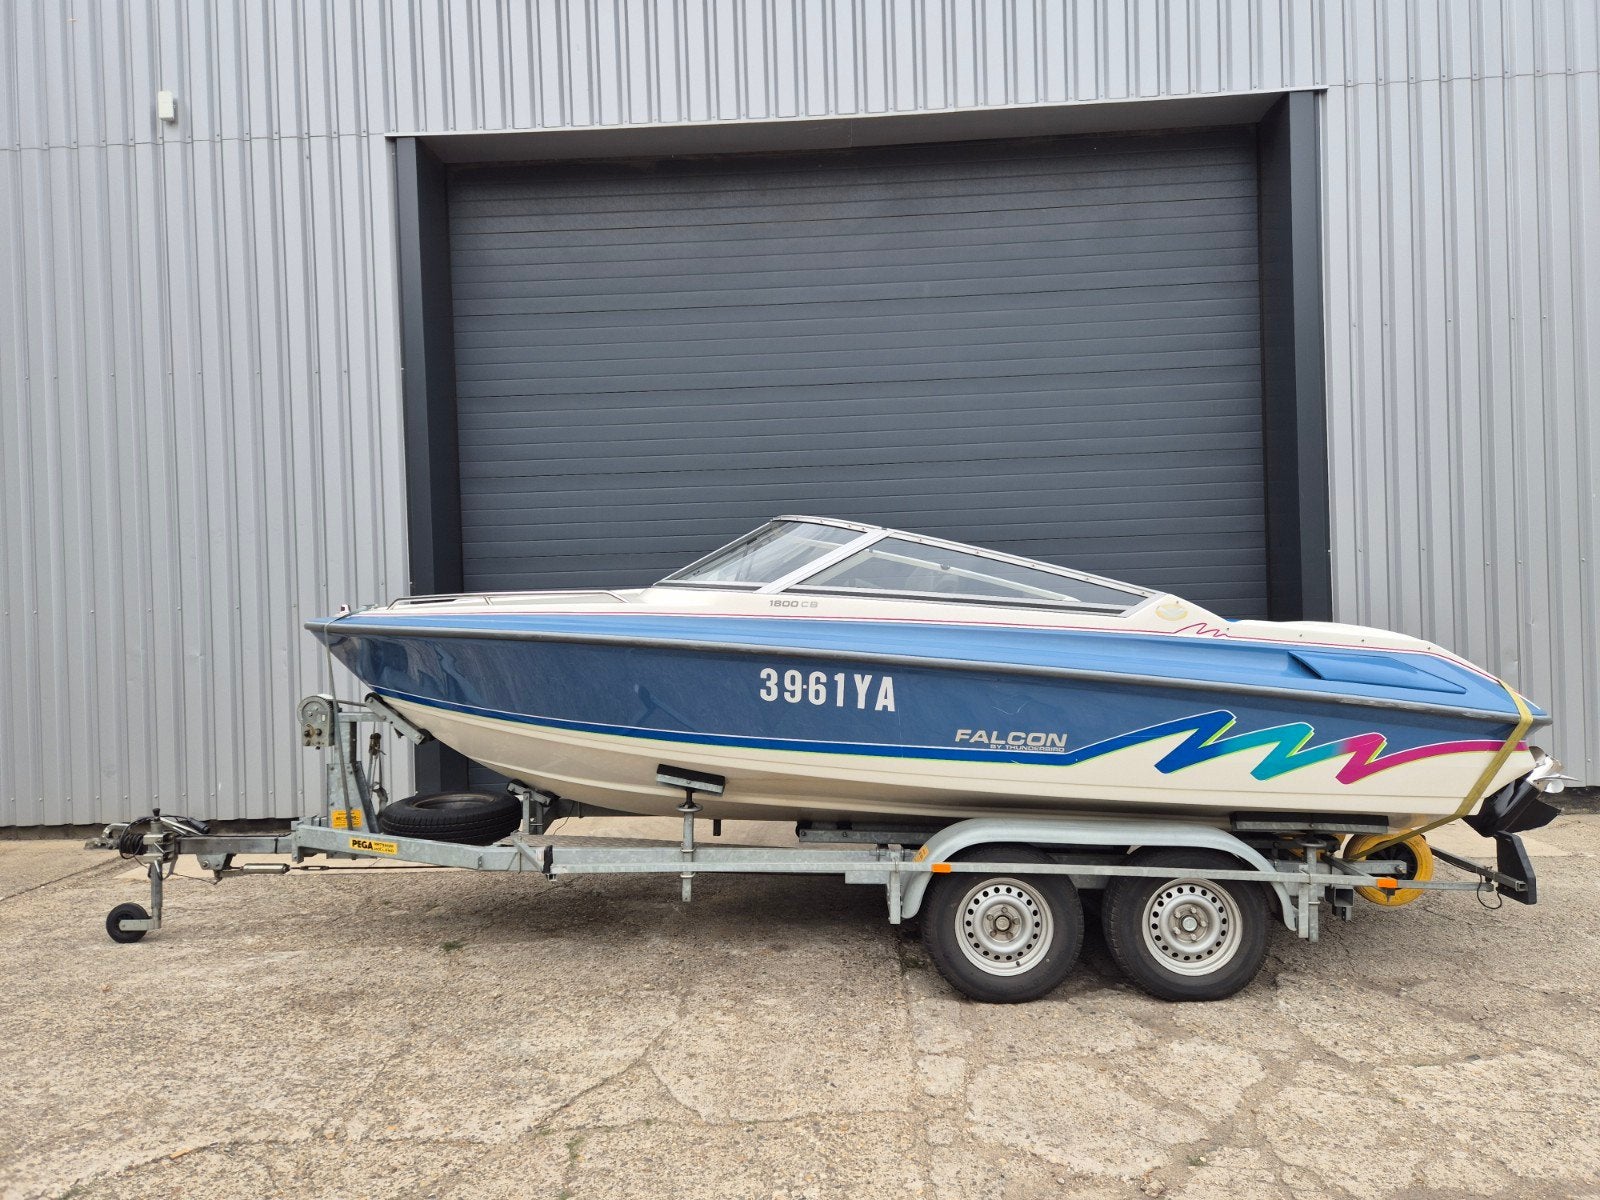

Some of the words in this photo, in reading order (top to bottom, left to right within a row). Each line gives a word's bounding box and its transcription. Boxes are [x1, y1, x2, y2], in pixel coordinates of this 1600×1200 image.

[769, 600, 799, 608] 1800
[954, 729, 1068, 747] FALCON
[1005, 745, 1065, 753] THUNDERBIRD
[352, 839, 373, 850] PEGA
